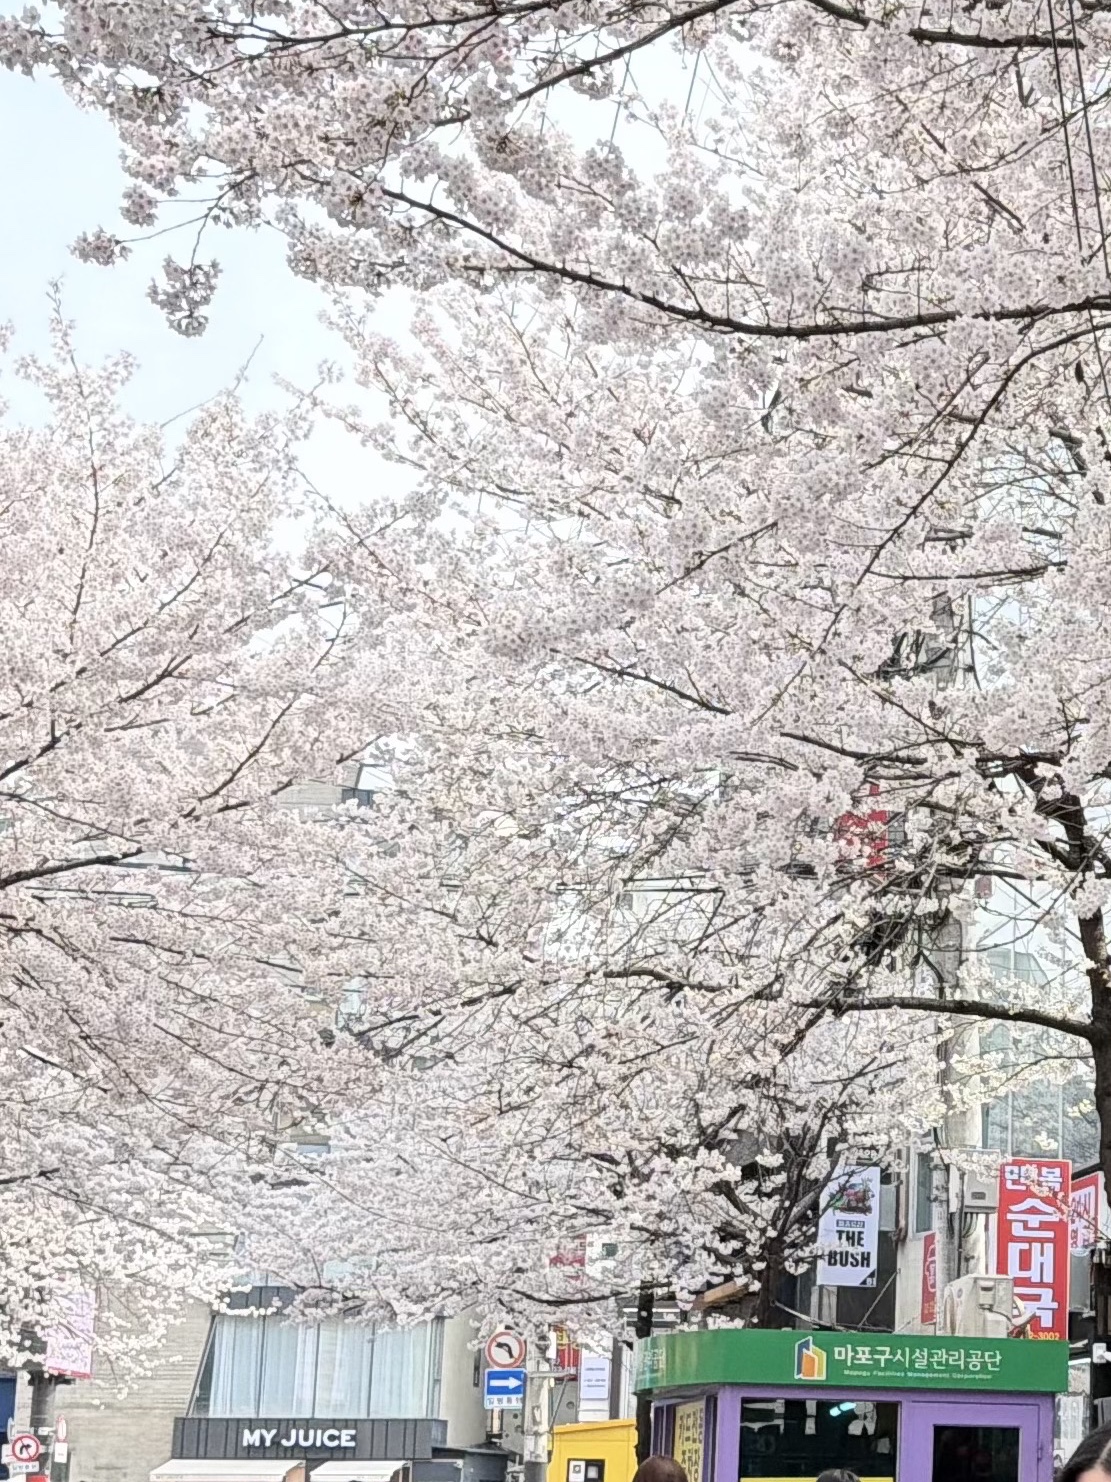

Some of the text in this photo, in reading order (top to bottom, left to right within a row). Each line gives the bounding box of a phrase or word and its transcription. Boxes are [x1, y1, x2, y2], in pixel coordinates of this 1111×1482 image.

[836, 1229, 865, 1247] THE
[827, 1249, 871, 1268] BUSH
[1006, 1197, 1061, 1328] 순대국
[834, 1343, 1003, 1371] 마포구시설관리공단
[242, 1428, 357, 1448] MY JUICE
